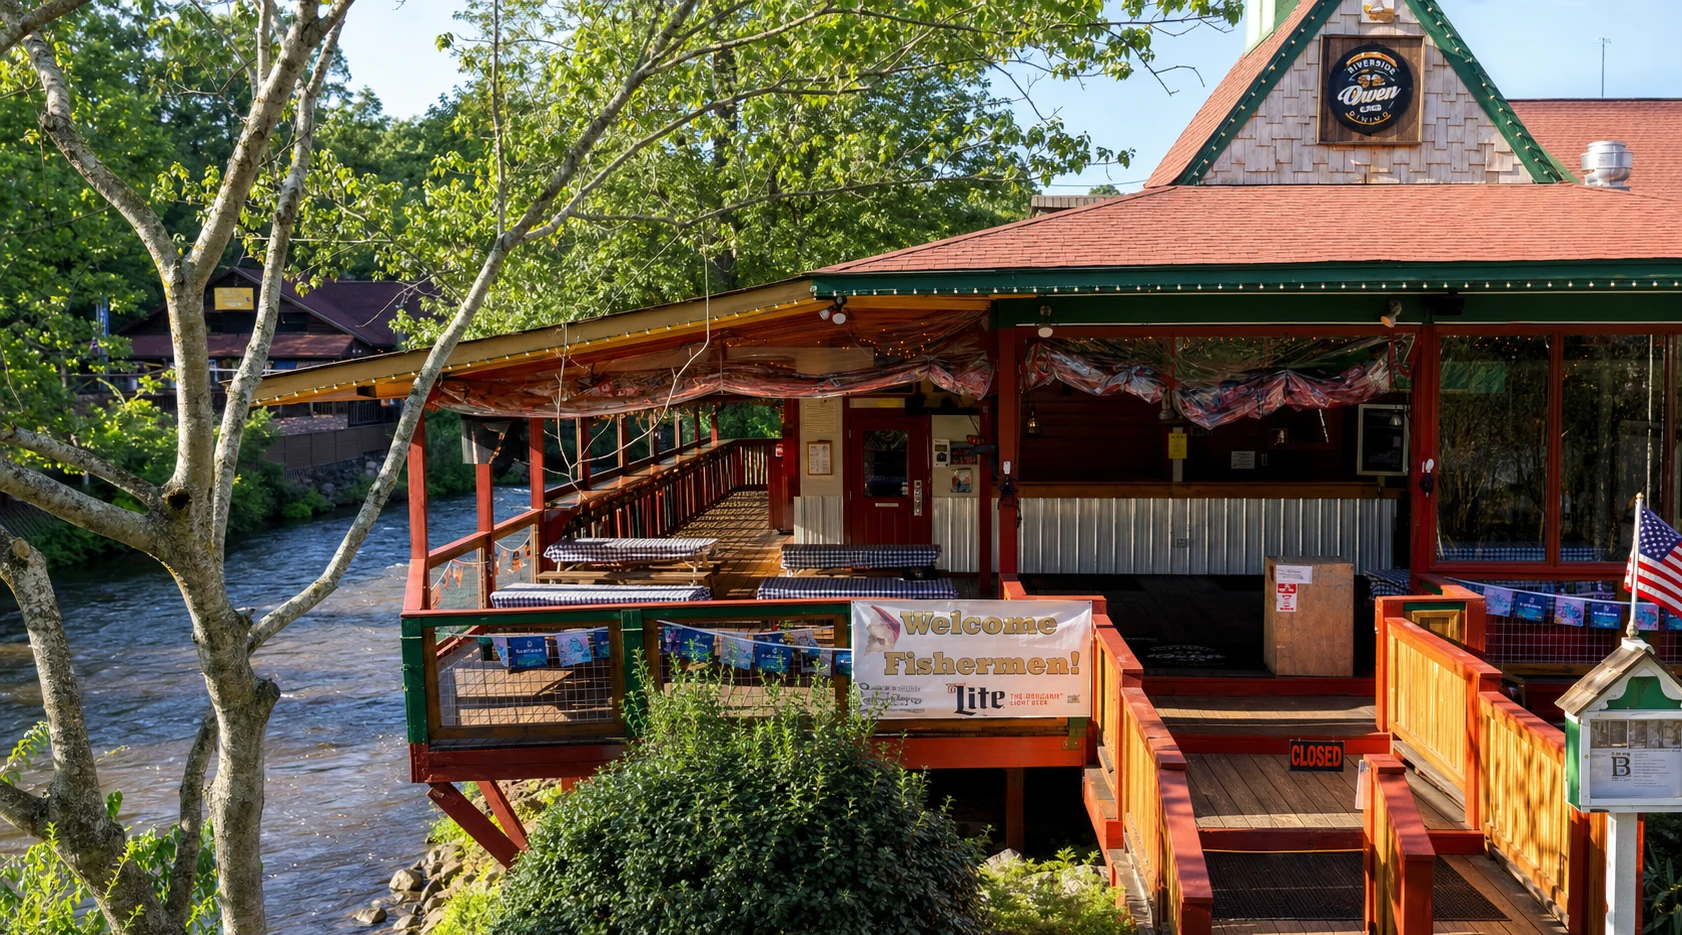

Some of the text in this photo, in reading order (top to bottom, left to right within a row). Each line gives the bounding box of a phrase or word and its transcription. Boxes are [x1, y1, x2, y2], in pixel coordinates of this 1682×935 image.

[1337, 85, 1401, 106] Owen
[899, 609, 1058, 636] Welcome
[883, 650, 1081, 676] Fishermen!
[953, 684, 1006, 716] Lite
[1291, 744, 1343, 767] CLOSED
